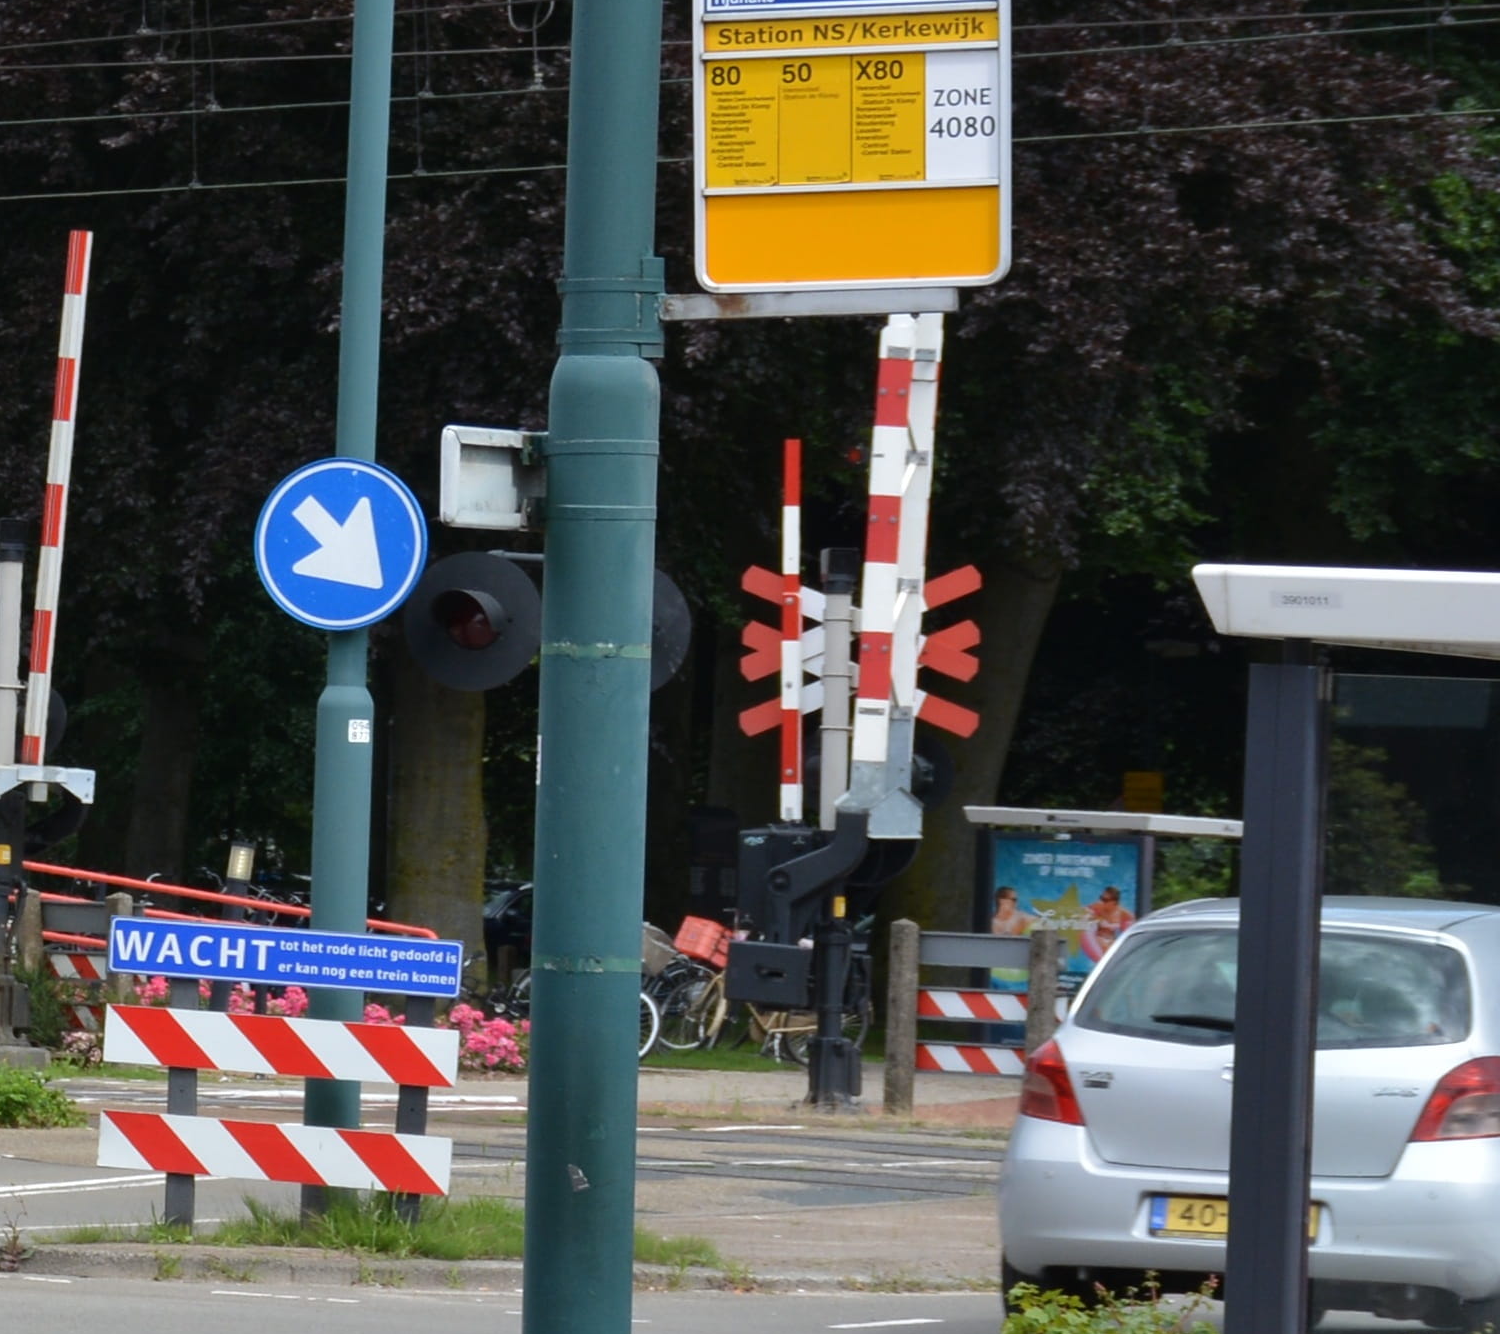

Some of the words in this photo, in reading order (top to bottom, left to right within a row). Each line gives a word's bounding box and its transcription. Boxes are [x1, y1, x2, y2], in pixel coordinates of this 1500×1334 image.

[718, 27, 804, 46] Station
[813, 17, 984, 42] NS/Kerkewijk
[711, 66, 741, 86] 80
[782, 63, 812, 83] 50
[855, 60, 903, 81] X80
[933, 88, 992, 107] ZONE
[929, 116, 996, 138] 4080
[115, 929, 276, 972] WACHT
[280, 940, 300, 952] tot
[302, 941, 324, 953] het
[326, 943, 356, 956] rode
[359, 946, 388, 959] licht
[390, 948, 443, 963] gedoofd
[446, 952, 458, 964] is
[278, 963, 292, 973] er
[295, 962, 318, 975] kan
[322, 966, 346, 979] nog
[349, 969, 374, 979] een
[376, 968, 409, 982] trein
[412, 971, 456, 986] komen
